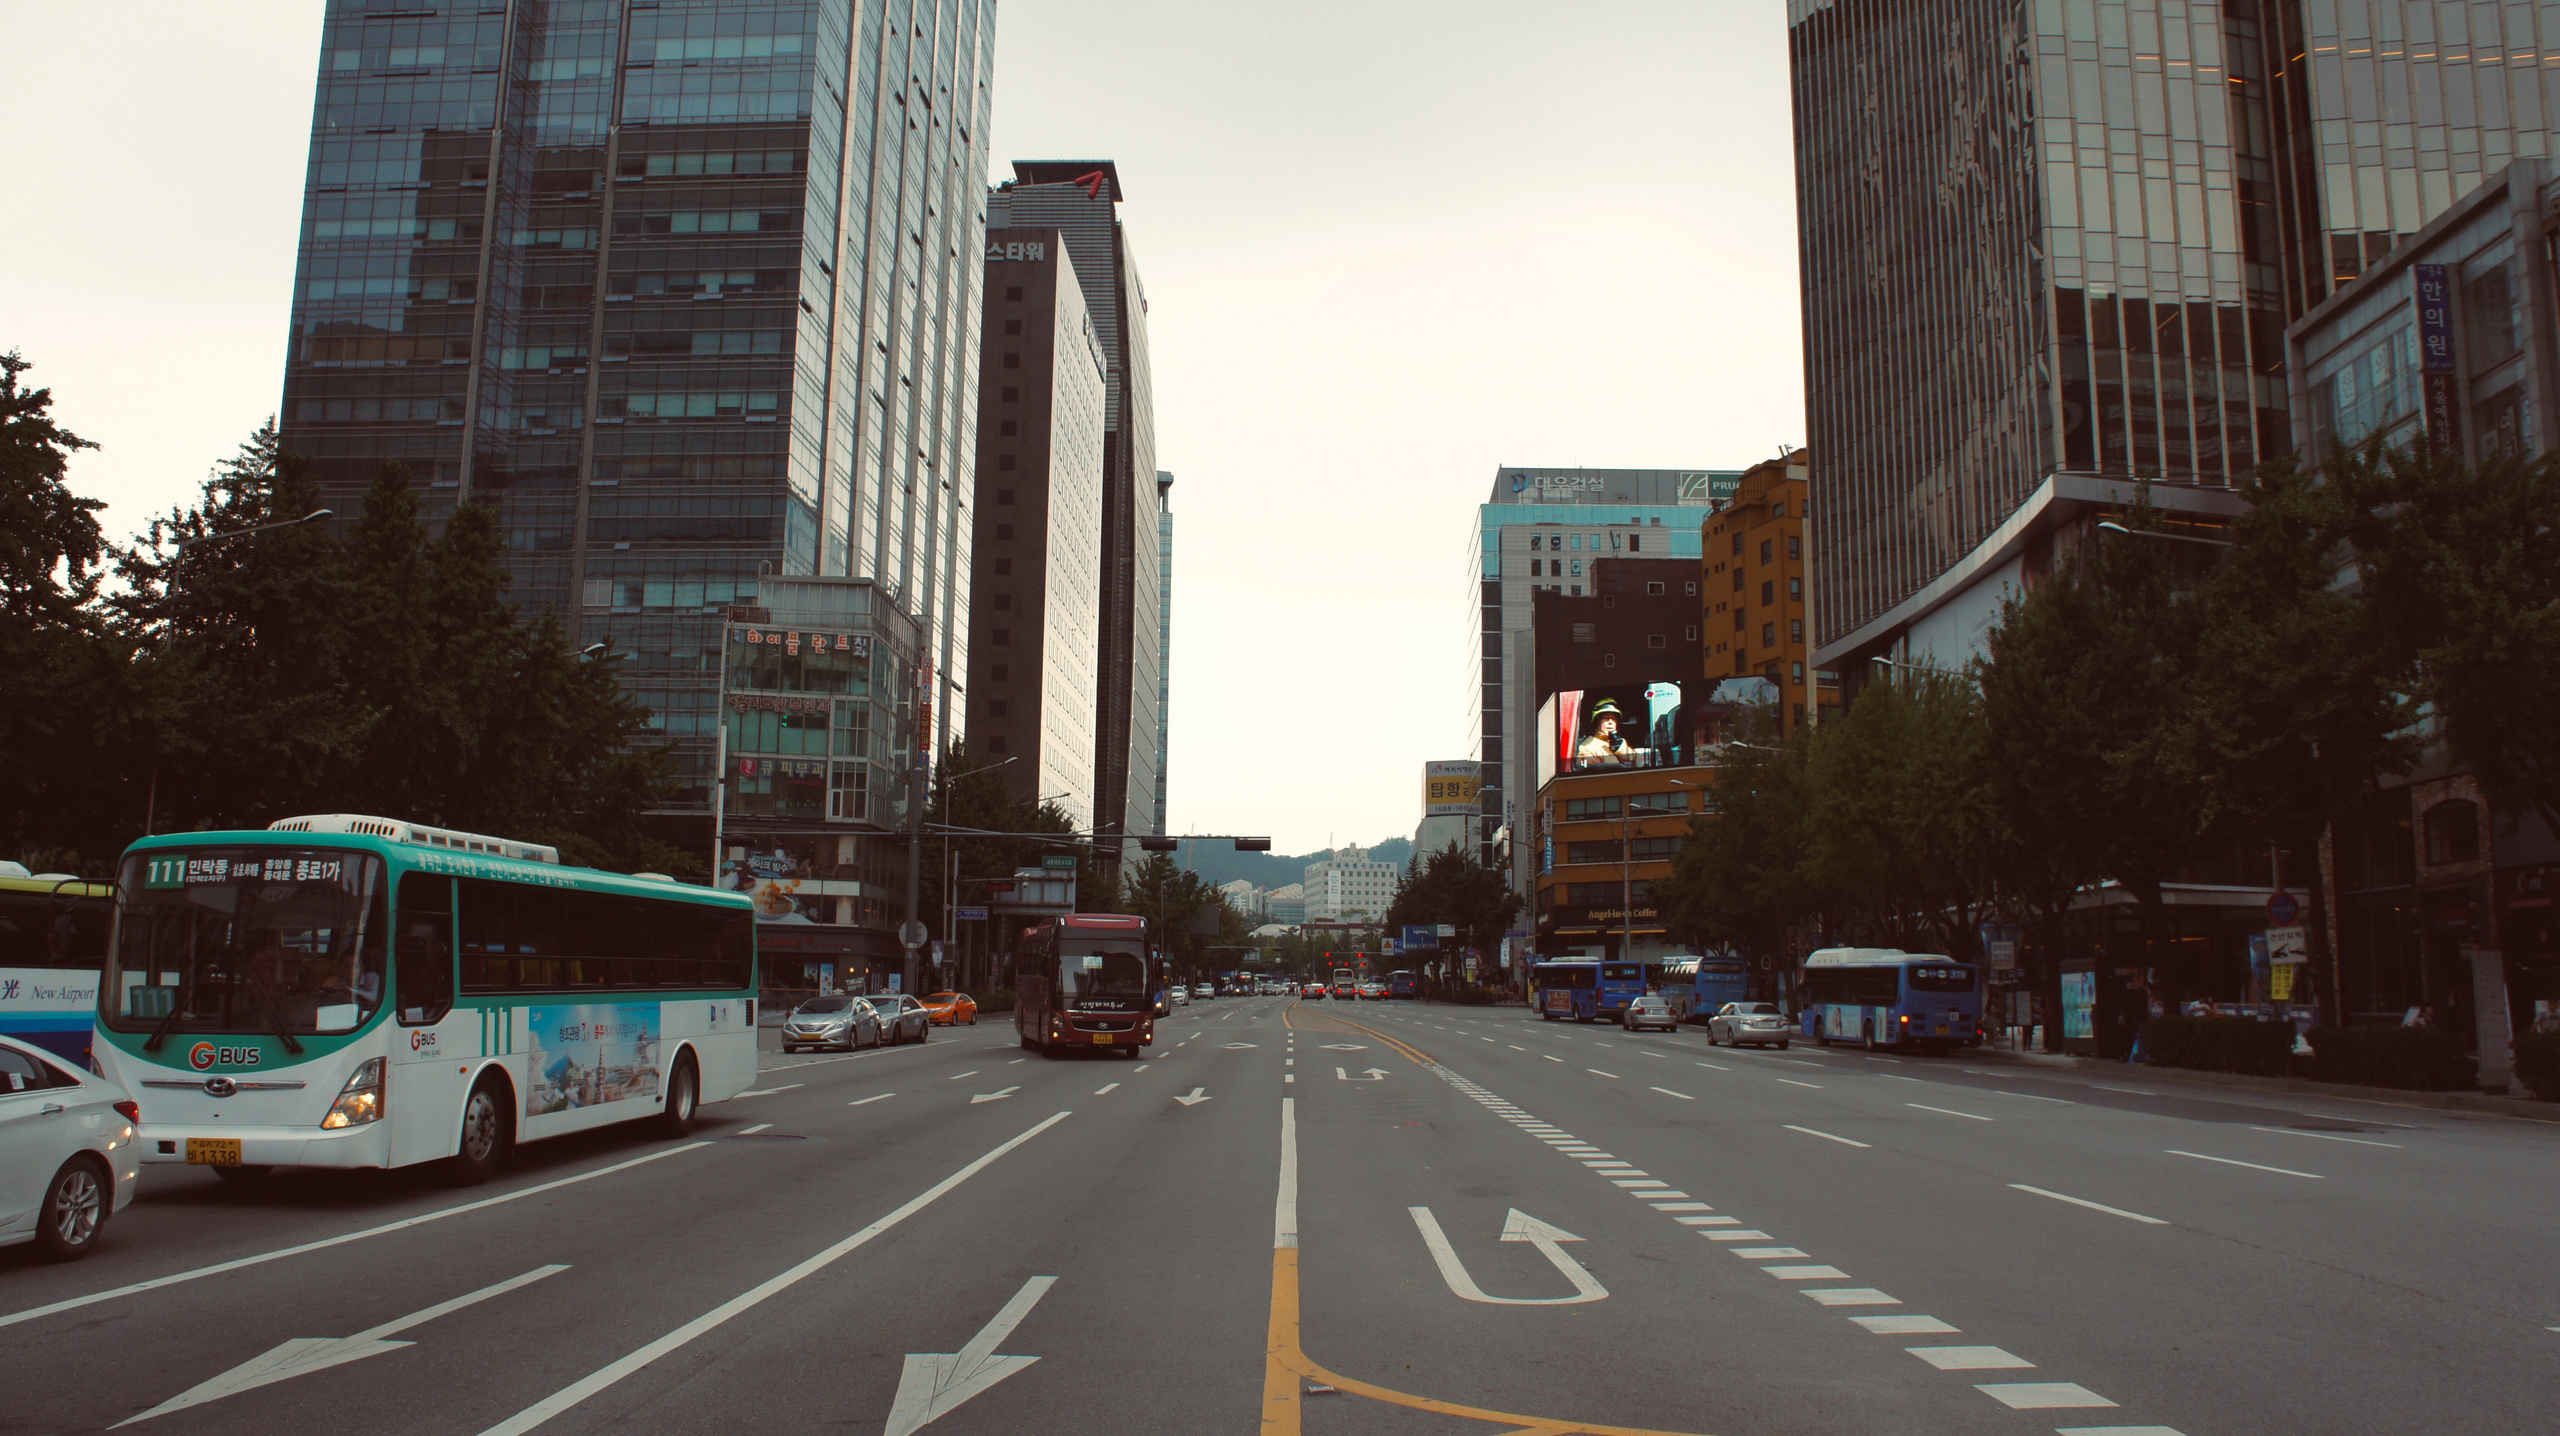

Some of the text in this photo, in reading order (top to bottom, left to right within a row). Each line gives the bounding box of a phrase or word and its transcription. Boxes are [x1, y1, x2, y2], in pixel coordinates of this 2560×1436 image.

[986, 242, 1044, 262] 스타워
[2420, 280, 2447, 356] 한의원
[1534, 476, 1604, 492] 대우건설
[748, 630, 849, 656] 하이플란트
[853, 636, 867, 658] 치과
[761, 760, 826, 779] 큐피부과
[149, 860, 186, 882] 111
[189, 859, 228, 874] 민락동
[263, 870, 291, 881] 동대문
[296, 860, 340, 882] 종로1가
[1633, 908, 1657, 918] Coffee
[1, 979, 20, 1000] 光
[31, 986, 95, 1003] New Airport
[421, 1032, 437, 1046] BUS
[477, 1007, 512, 1057] 111
[218, 1046, 260, 1065] BUS
